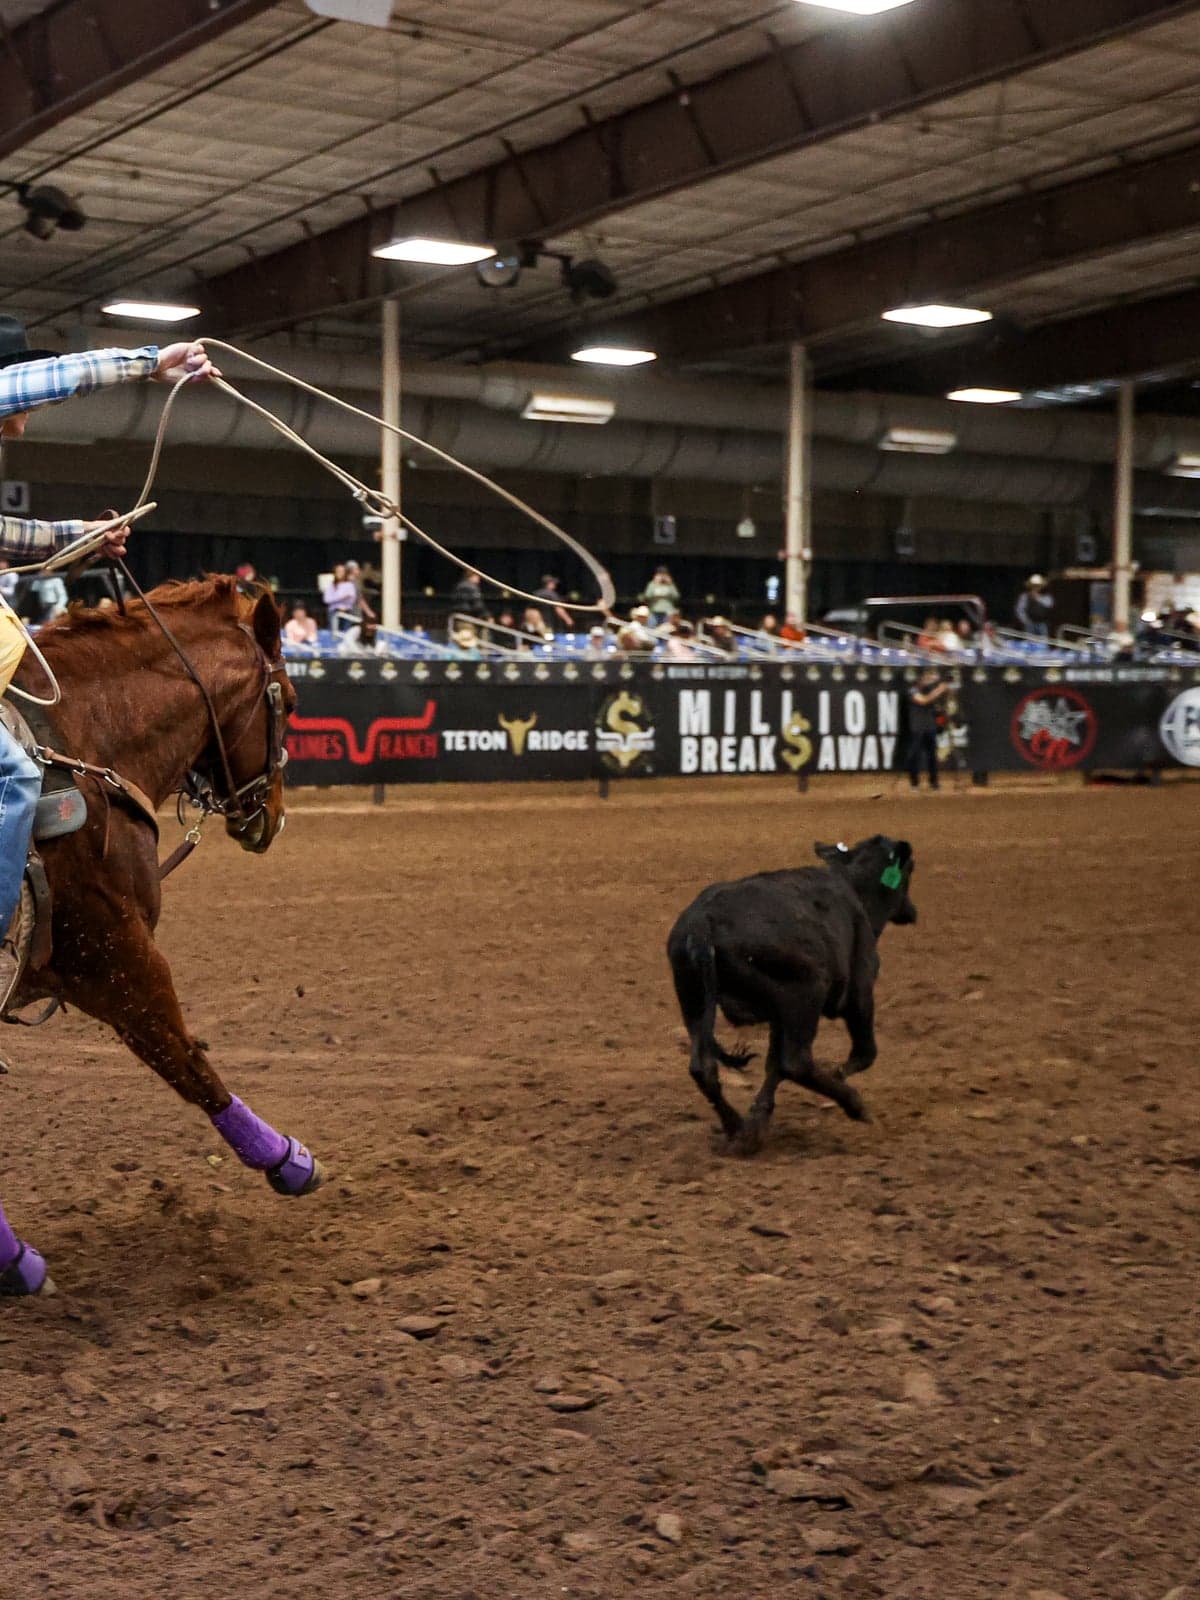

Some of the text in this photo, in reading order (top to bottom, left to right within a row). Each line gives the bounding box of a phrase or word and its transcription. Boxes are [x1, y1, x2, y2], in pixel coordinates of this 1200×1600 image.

[7, 486, 23, 506] J
[679, 689, 898, 735] MILLION
[379, 734, 438, 759] RANCH
[442, 730, 507, 750] TETON
[528, 730, 588, 750] RIDGE
[681, 735, 776, 773] BREAK
[818, 735, 896, 771] AWAY
